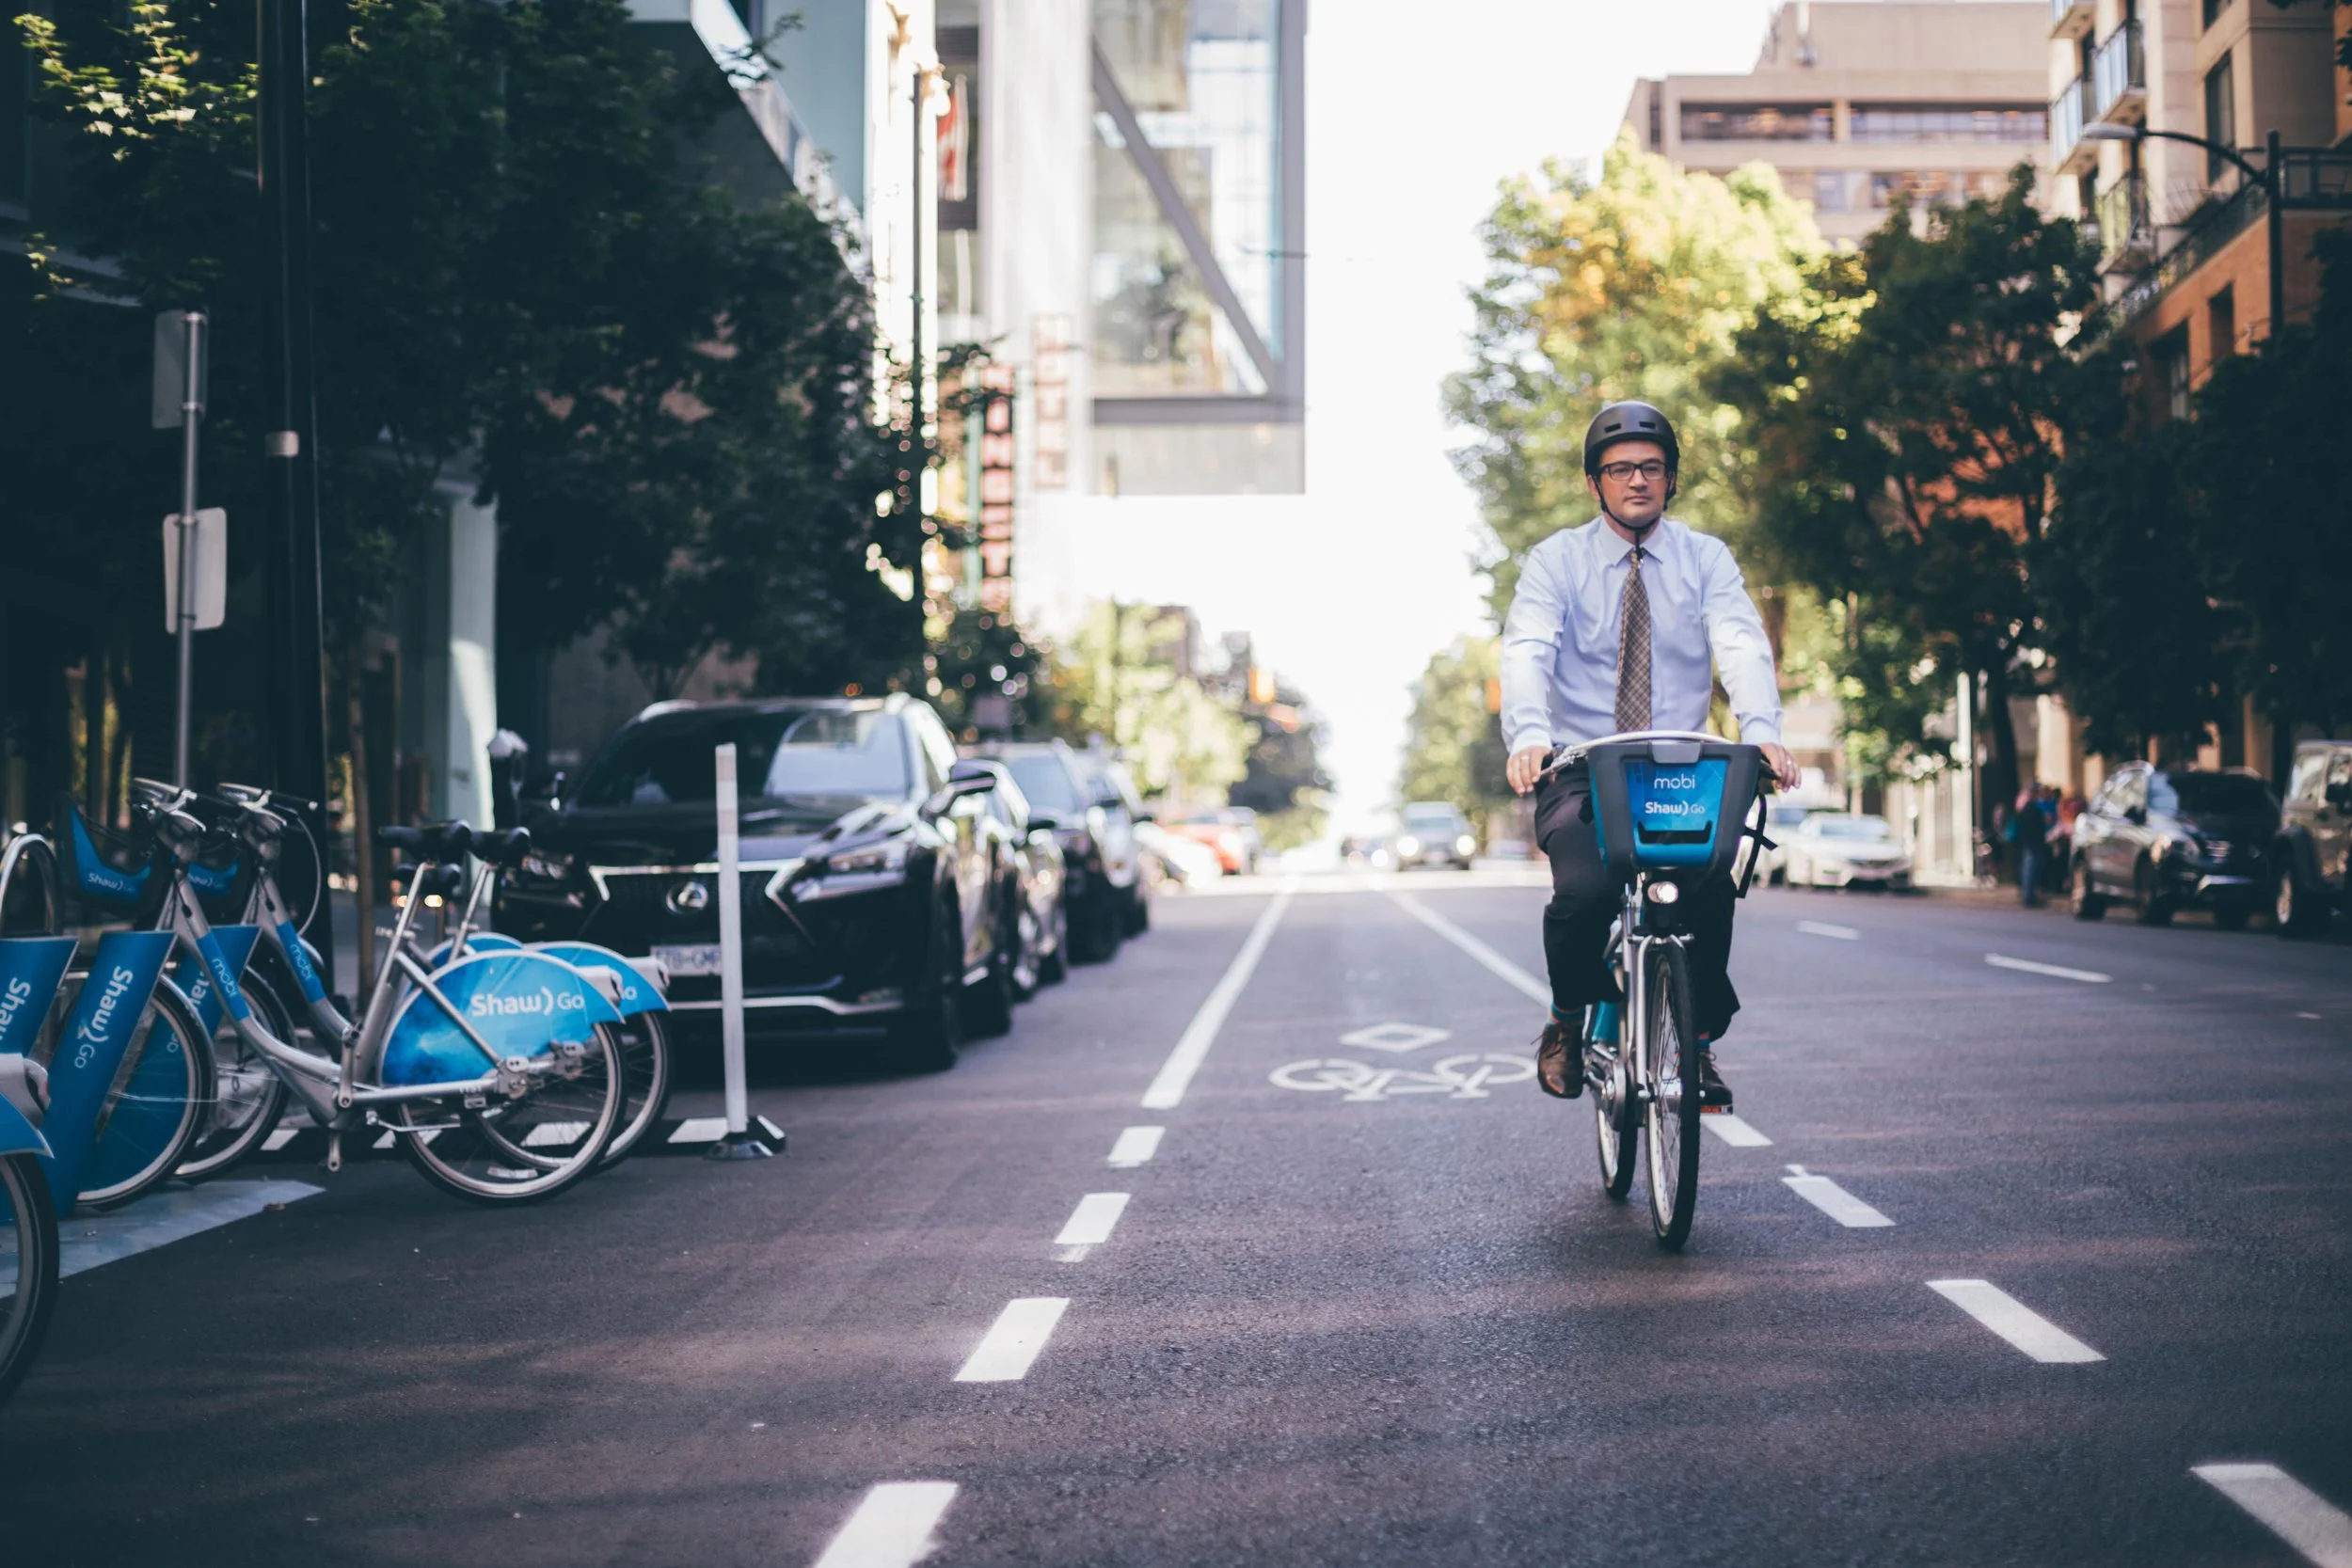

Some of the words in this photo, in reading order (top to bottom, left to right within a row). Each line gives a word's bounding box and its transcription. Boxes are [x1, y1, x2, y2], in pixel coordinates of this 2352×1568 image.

[1654, 773, 1695, 789] mobi
[1690, 804, 1706, 814] Go
[212, 958, 238, 998] mobi
[557, 991, 585, 1010] Go
[74, 1043, 95, 1069] Go
